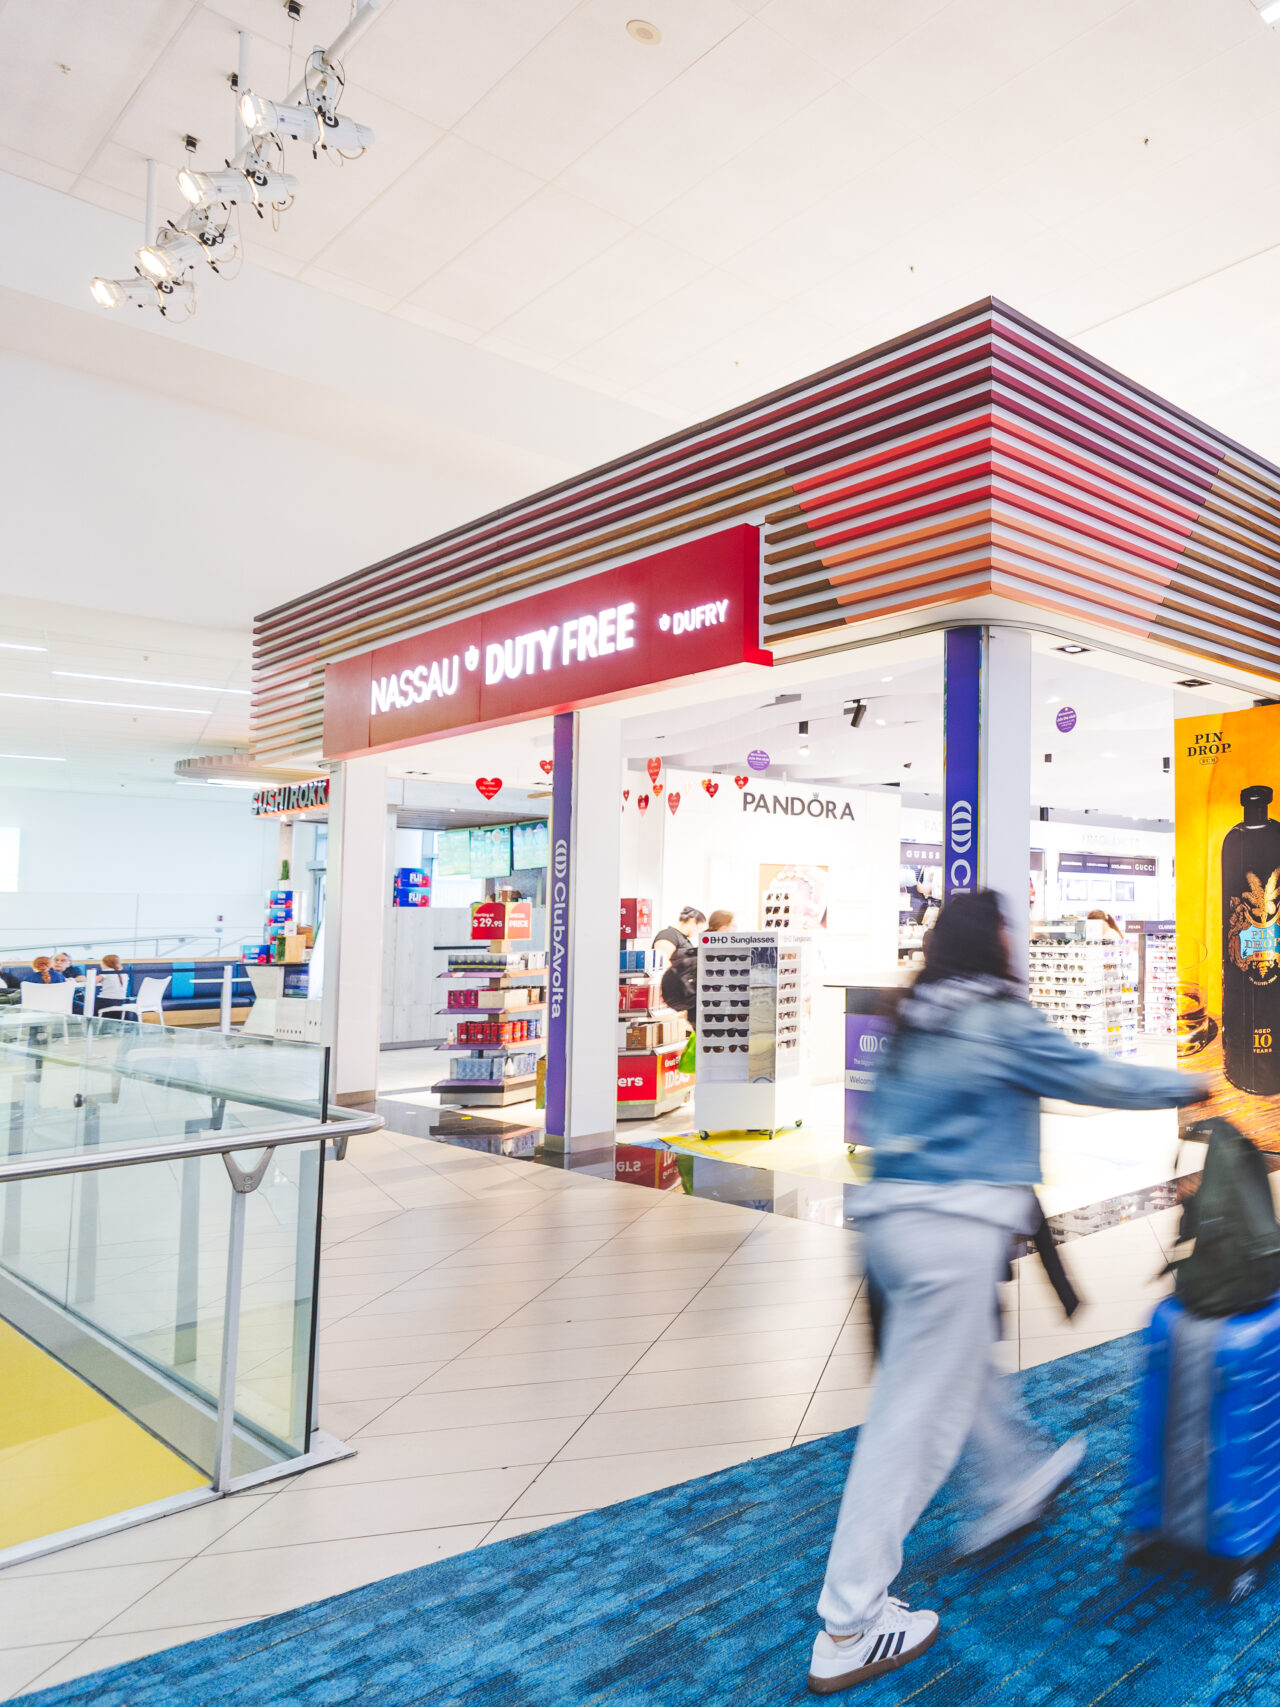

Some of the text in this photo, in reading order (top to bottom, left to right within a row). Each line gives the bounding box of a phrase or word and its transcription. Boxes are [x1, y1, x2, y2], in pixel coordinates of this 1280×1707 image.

[673, 599, 729, 635] DUFRY
[370, 602, 635, 715] NASSAU DUTY FREE
[1194, 731, 1223, 745] PIN
[1187, 742, 1231, 757] DROP
[251, 778, 330, 815] SUSHI ROKK
[743, 791, 855, 821] PANDORA
[905, 850, 941, 860] GUESS
[1134, 863, 1155, 872] GUCCI
[472, 917, 503, 927] $ 29.95
[730, 935, 776, 945] Sunglasses
[1251, 927, 1275, 939] PIN
[551, 882, 568, 1018] ClubAvolta
[1245, 937, 1280, 949] DROP
[1253, 1034, 1272, 1048] 10
[617, 1076, 643, 1088] ers
